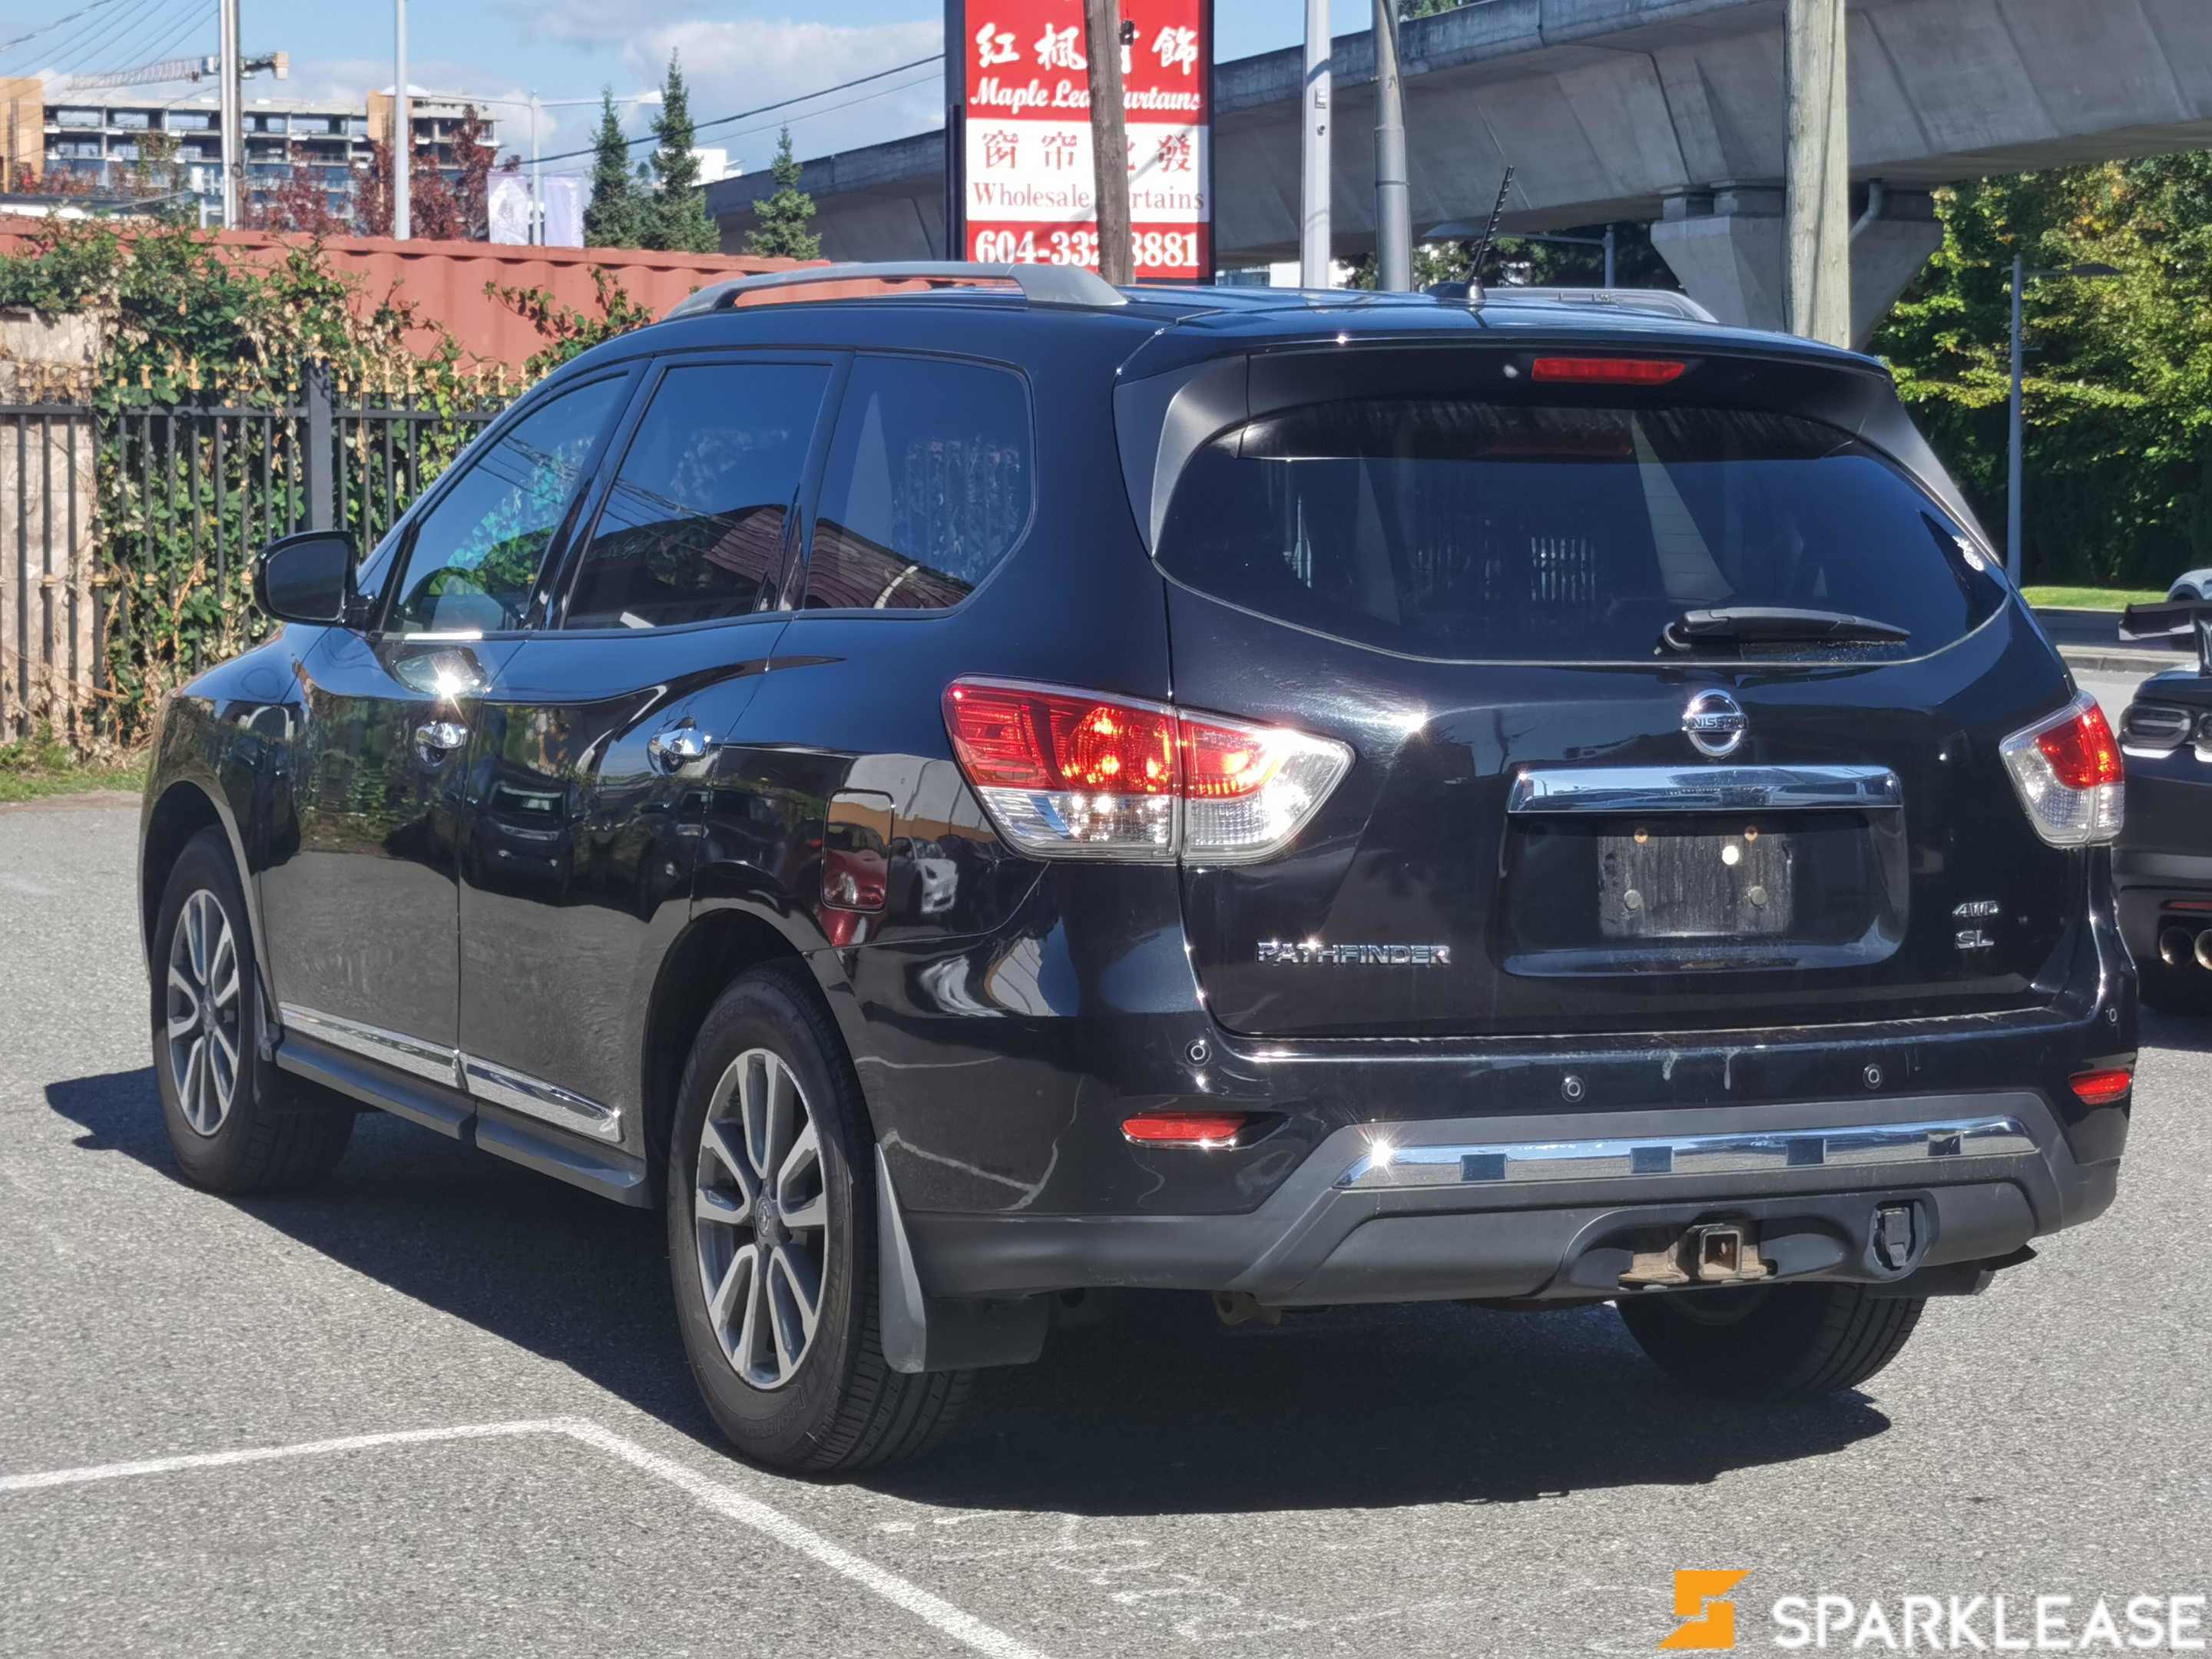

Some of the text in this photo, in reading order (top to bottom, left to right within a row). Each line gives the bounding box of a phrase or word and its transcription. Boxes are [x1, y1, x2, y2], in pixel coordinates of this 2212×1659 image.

[975, 22, 1198, 75] 紅楓飾
[970, 76, 1204, 114] Maple Lea urtains
[982, 129, 1192, 173] 窗帘發
[972, 182, 1204, 210] Wholesale rtains
[1692, 717, 1746, 730] NISSAN
[1256, 939, 1451, 965] PATHFINDER
[1955, 929, 1995, 949] SL
